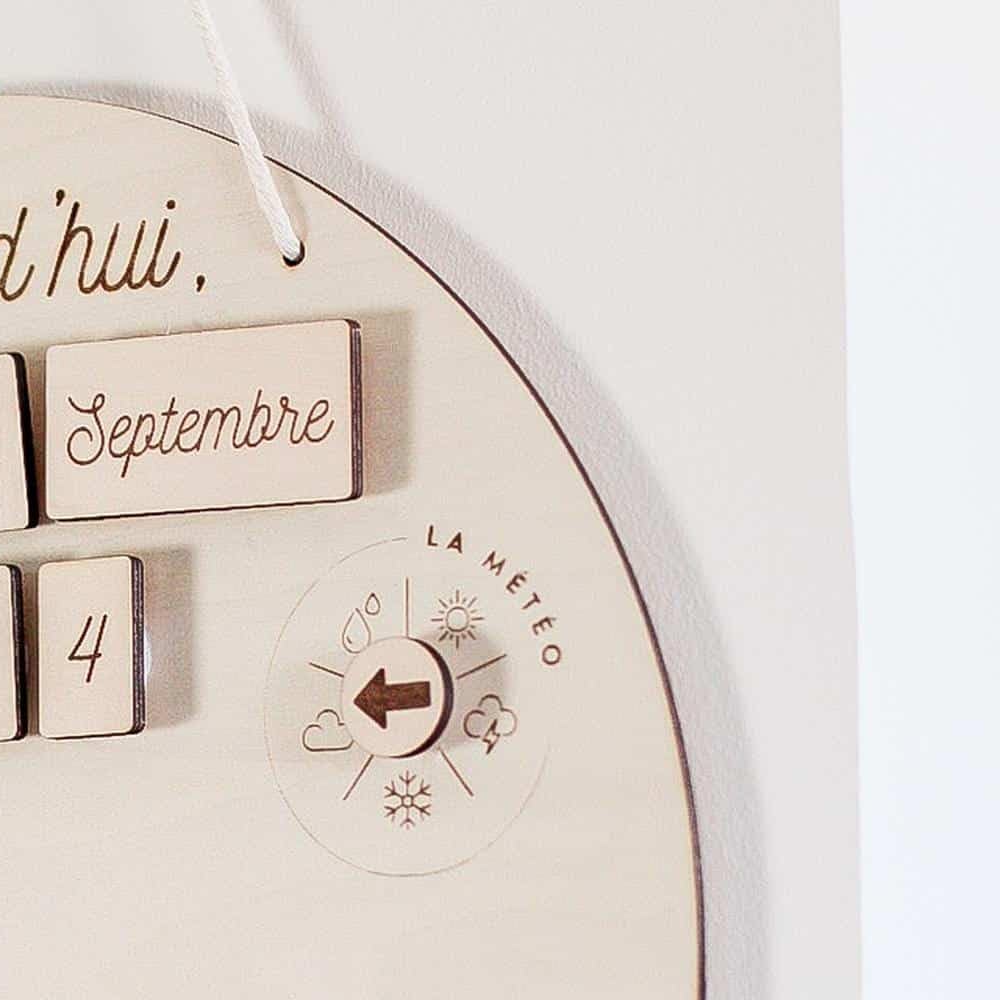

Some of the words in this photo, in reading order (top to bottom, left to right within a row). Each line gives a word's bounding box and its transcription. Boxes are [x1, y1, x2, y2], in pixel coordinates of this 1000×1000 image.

[66, 389, 336, 479] Septembre
[426, 524, 463, 554] LA
[481, 550, 562, 666] MÉTÉO
